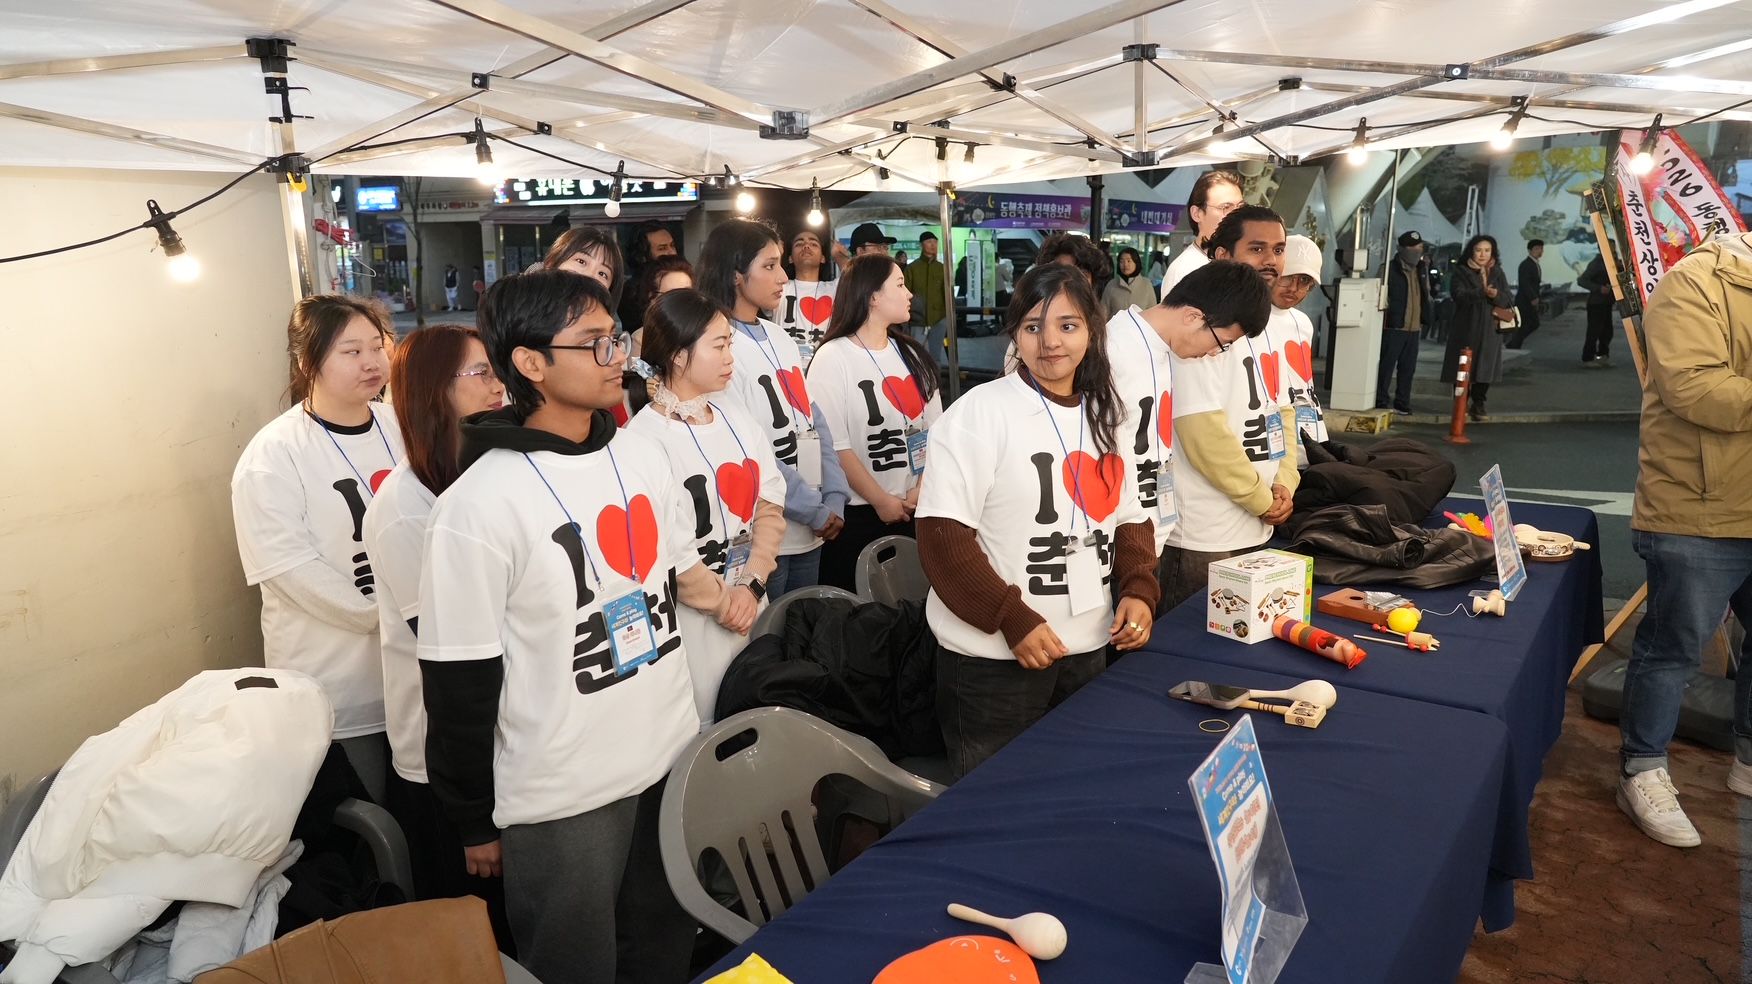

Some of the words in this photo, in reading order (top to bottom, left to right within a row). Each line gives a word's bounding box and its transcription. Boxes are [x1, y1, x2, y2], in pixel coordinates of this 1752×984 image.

[1000, 201, 1033, 218] 동행축제
[1035, 202, 1072, 219] 정책홍보관
[785, 295, 797, 323] I
[758, 374, 789, 430] I
[858, 379, 884, 426] I
[1243, 356, 1261, 410] I
[867, 428, 908, 472] 춘
[1133, 395, 1154, 455] I
[333, 478, 366, 541] I
[683, 474, 713, 539] I
[1030, 452, 1059, 525] I
[551, 521, 595, 610] I
